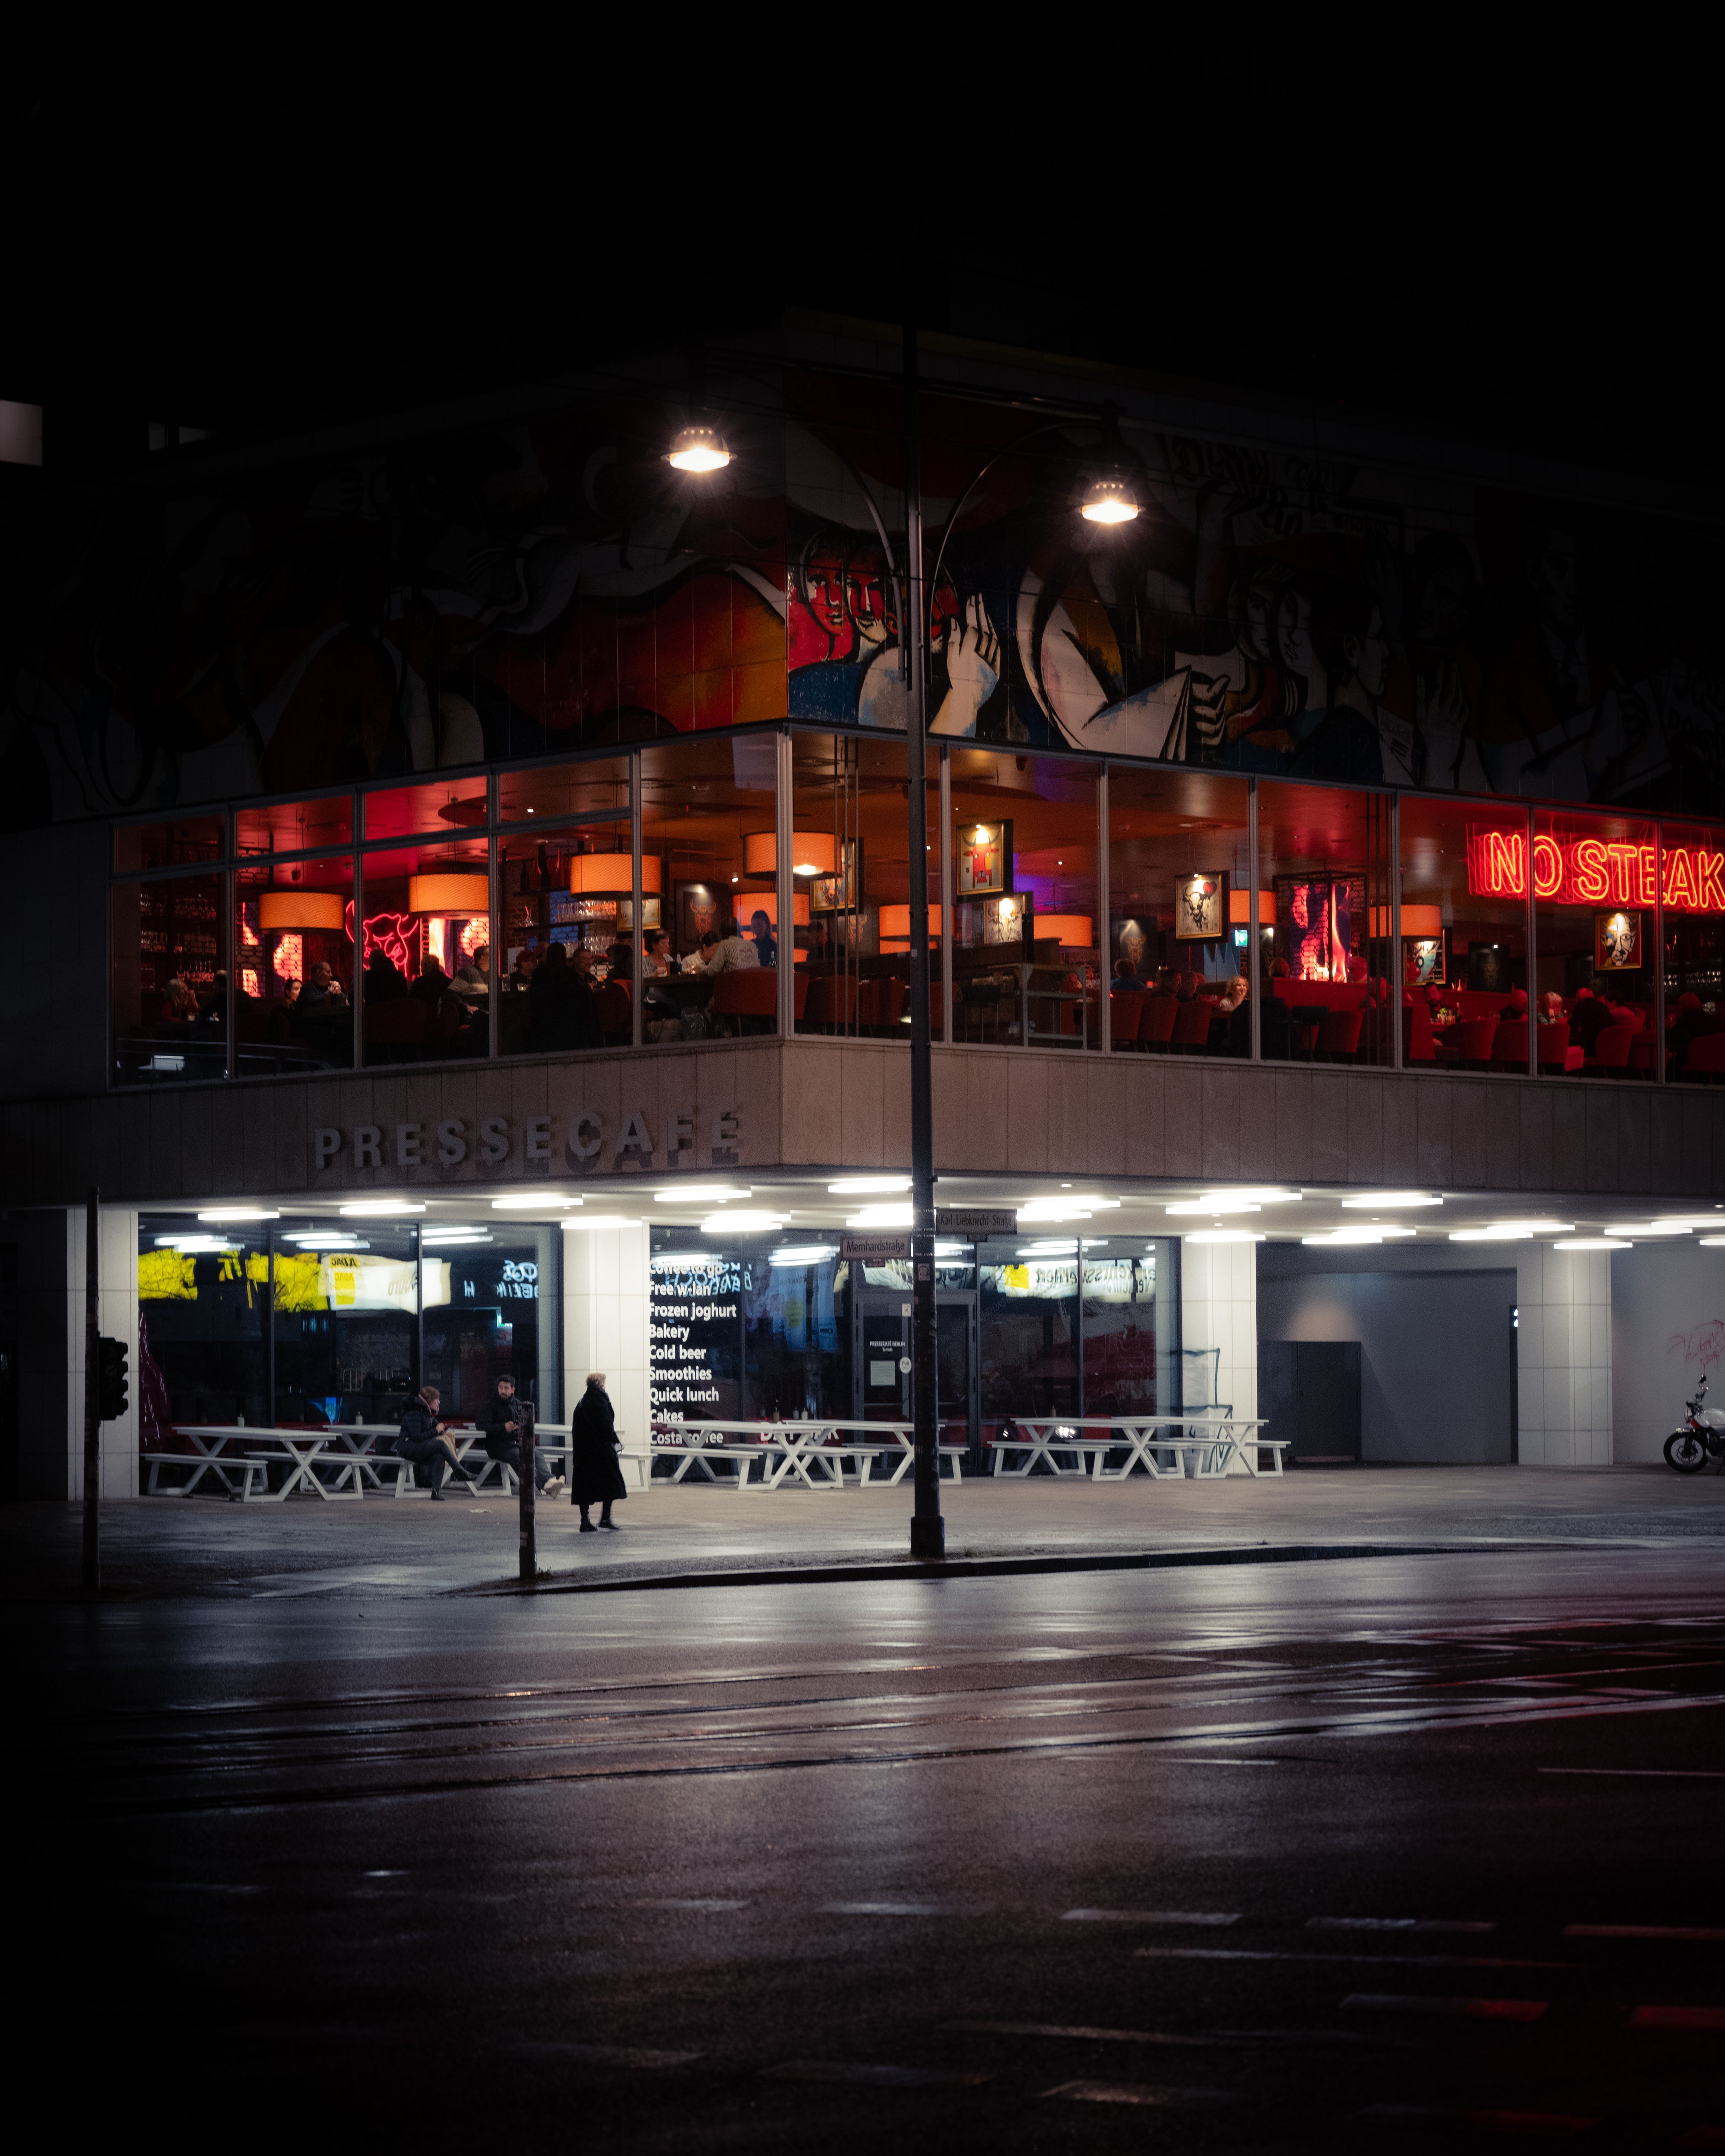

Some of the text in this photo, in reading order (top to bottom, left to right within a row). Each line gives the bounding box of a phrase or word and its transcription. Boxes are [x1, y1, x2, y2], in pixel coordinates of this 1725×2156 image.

[1490, 832, 1725, 910] NO STEAK
[846, 1239, 905, 1253] Memhardstraße
[650, 1260, 687, 1274] Coffee
[706, 1264, 722, 1279] go
[650, 1280, 711, 1296] Free w-lan
[650, 1302, 737, 1321] Frozen joghurt
[650, 1323, 690, 1342] Bakery
[650, 1344, 706, 1360] Cold beer
[650, 1365, 712, 1381] Smoothies
[650, 1387, 719, 1405] Quick lunch
[650, 1408, 684, 1423] Cakes
[650, 1430, 682, 1445] Costa
